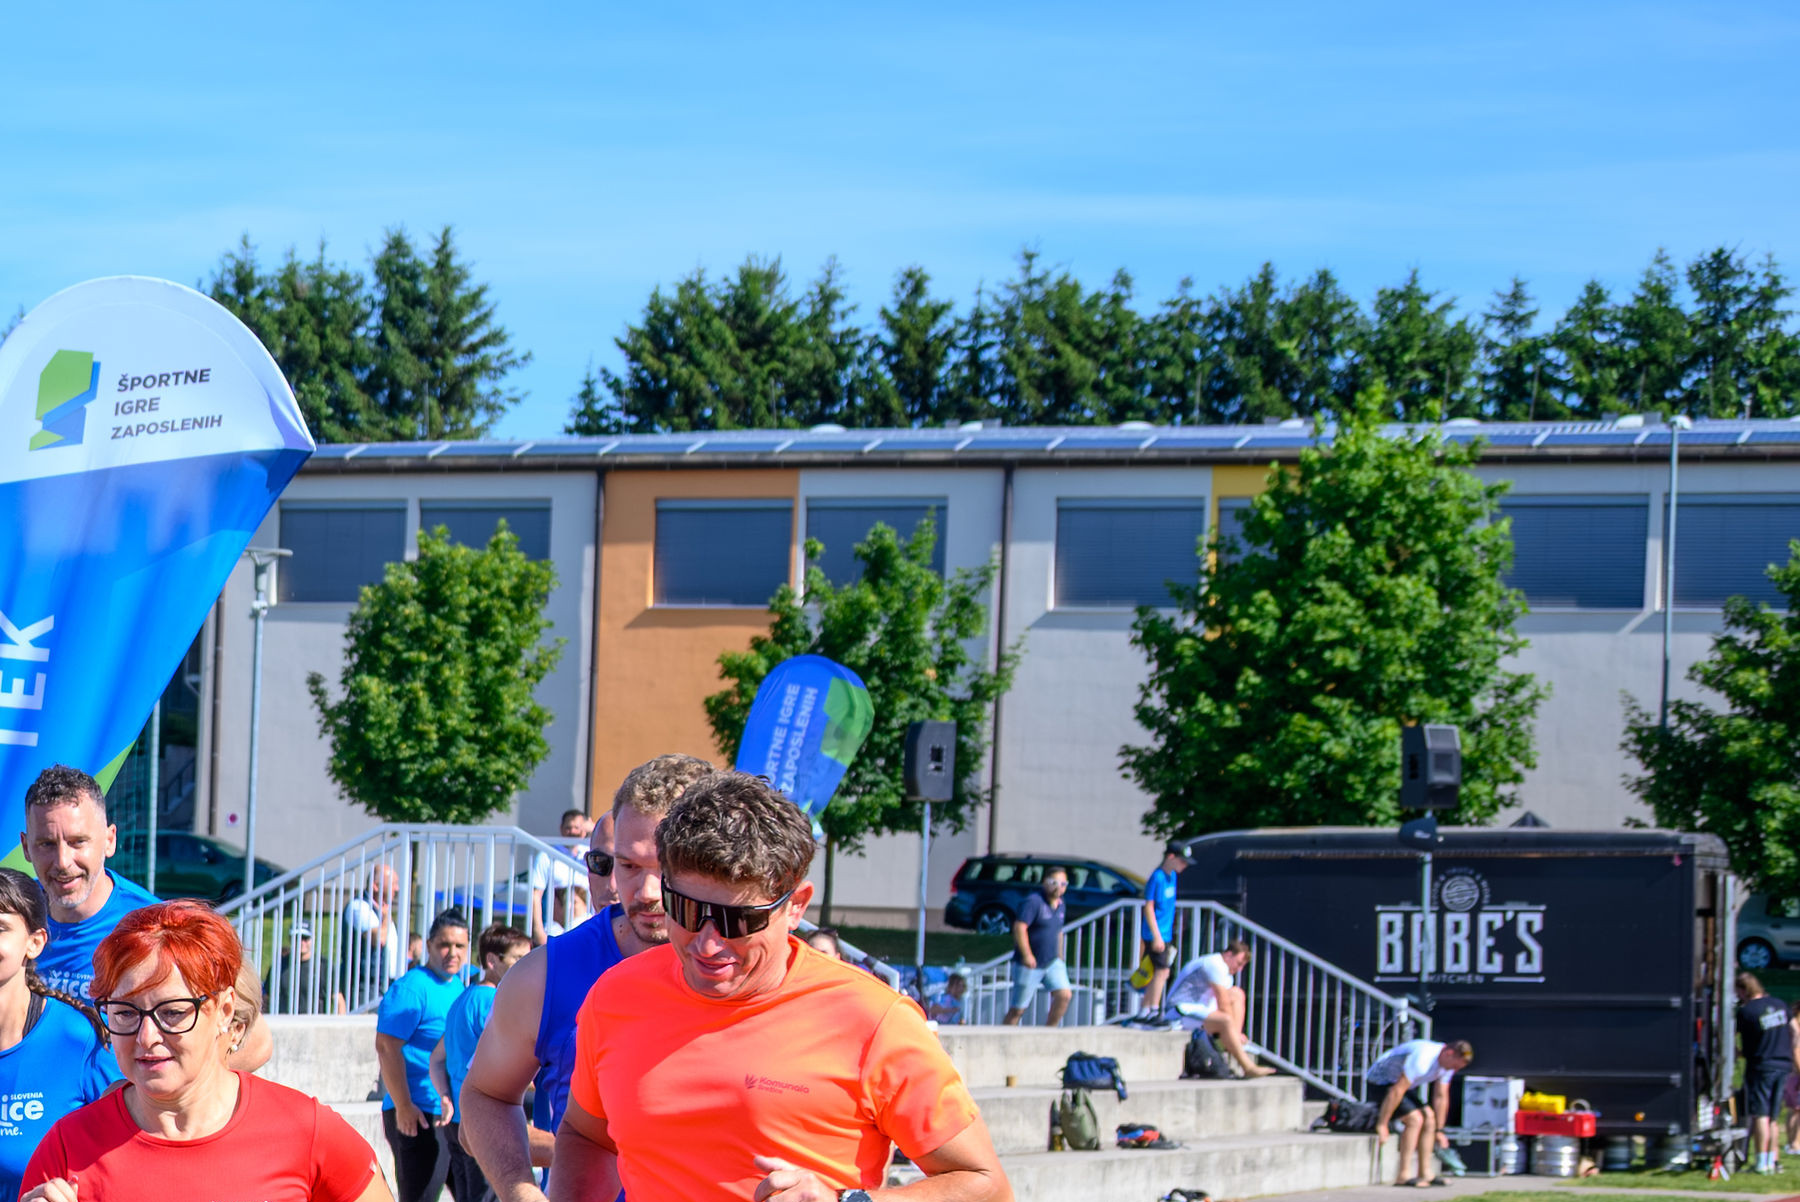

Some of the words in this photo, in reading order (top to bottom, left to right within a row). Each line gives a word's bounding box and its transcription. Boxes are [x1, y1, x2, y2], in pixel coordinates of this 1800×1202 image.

[117, 368, 211, 393] ŠPORTNE
[114, 397, 161, 417] IGRE
[110, 414, 223, 441] ZAPOSLENIH
[765, 725, 788, 786] ORTNE
[778, 683, 800, 724] IGRE
[781, 686, 819, 793] ZAPOSLENIH
[1376, 910, 1544, 974] BABE'S
[10, 1092, 44, 1101] SLOVENIA
